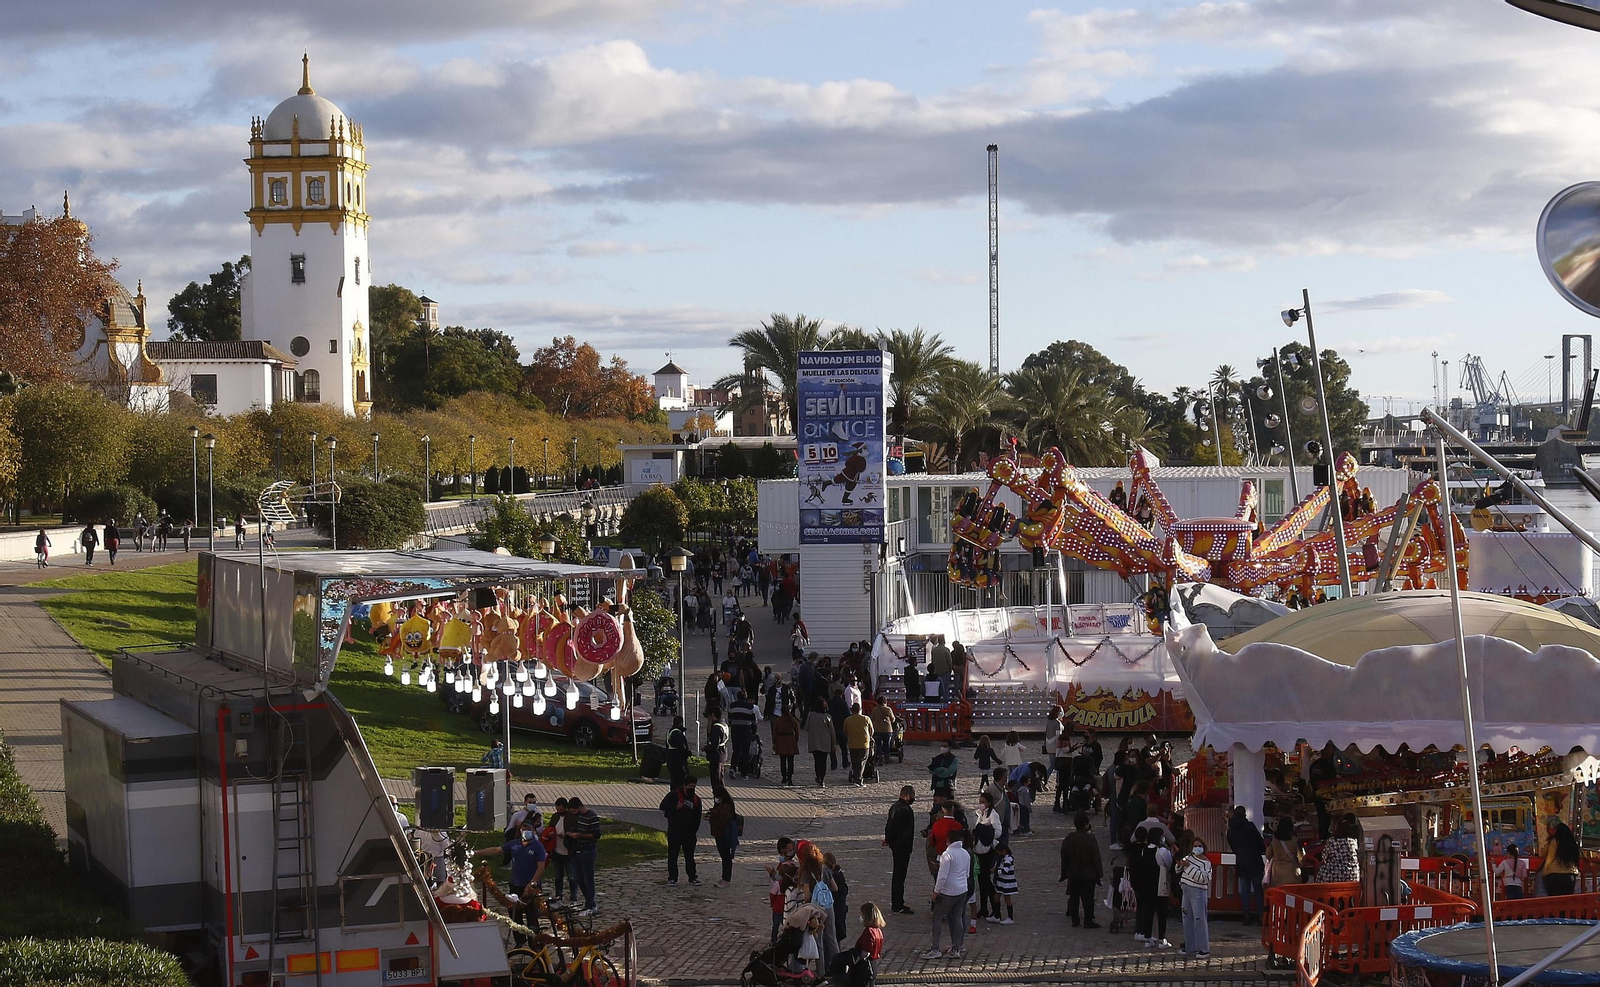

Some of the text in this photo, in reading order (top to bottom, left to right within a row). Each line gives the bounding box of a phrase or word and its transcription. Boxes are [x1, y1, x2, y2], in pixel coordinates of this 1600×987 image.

[800, 356, 842, 364] NAVIDAD
[806, 396, 875, 416] SEVILLA
[804, 420, 876, 438] ON ICE
[808, 447, 837, 459] 5 10
[1064, 702, 1158, 728] TARANTULA
[388, 970, 408, 978] 5033
